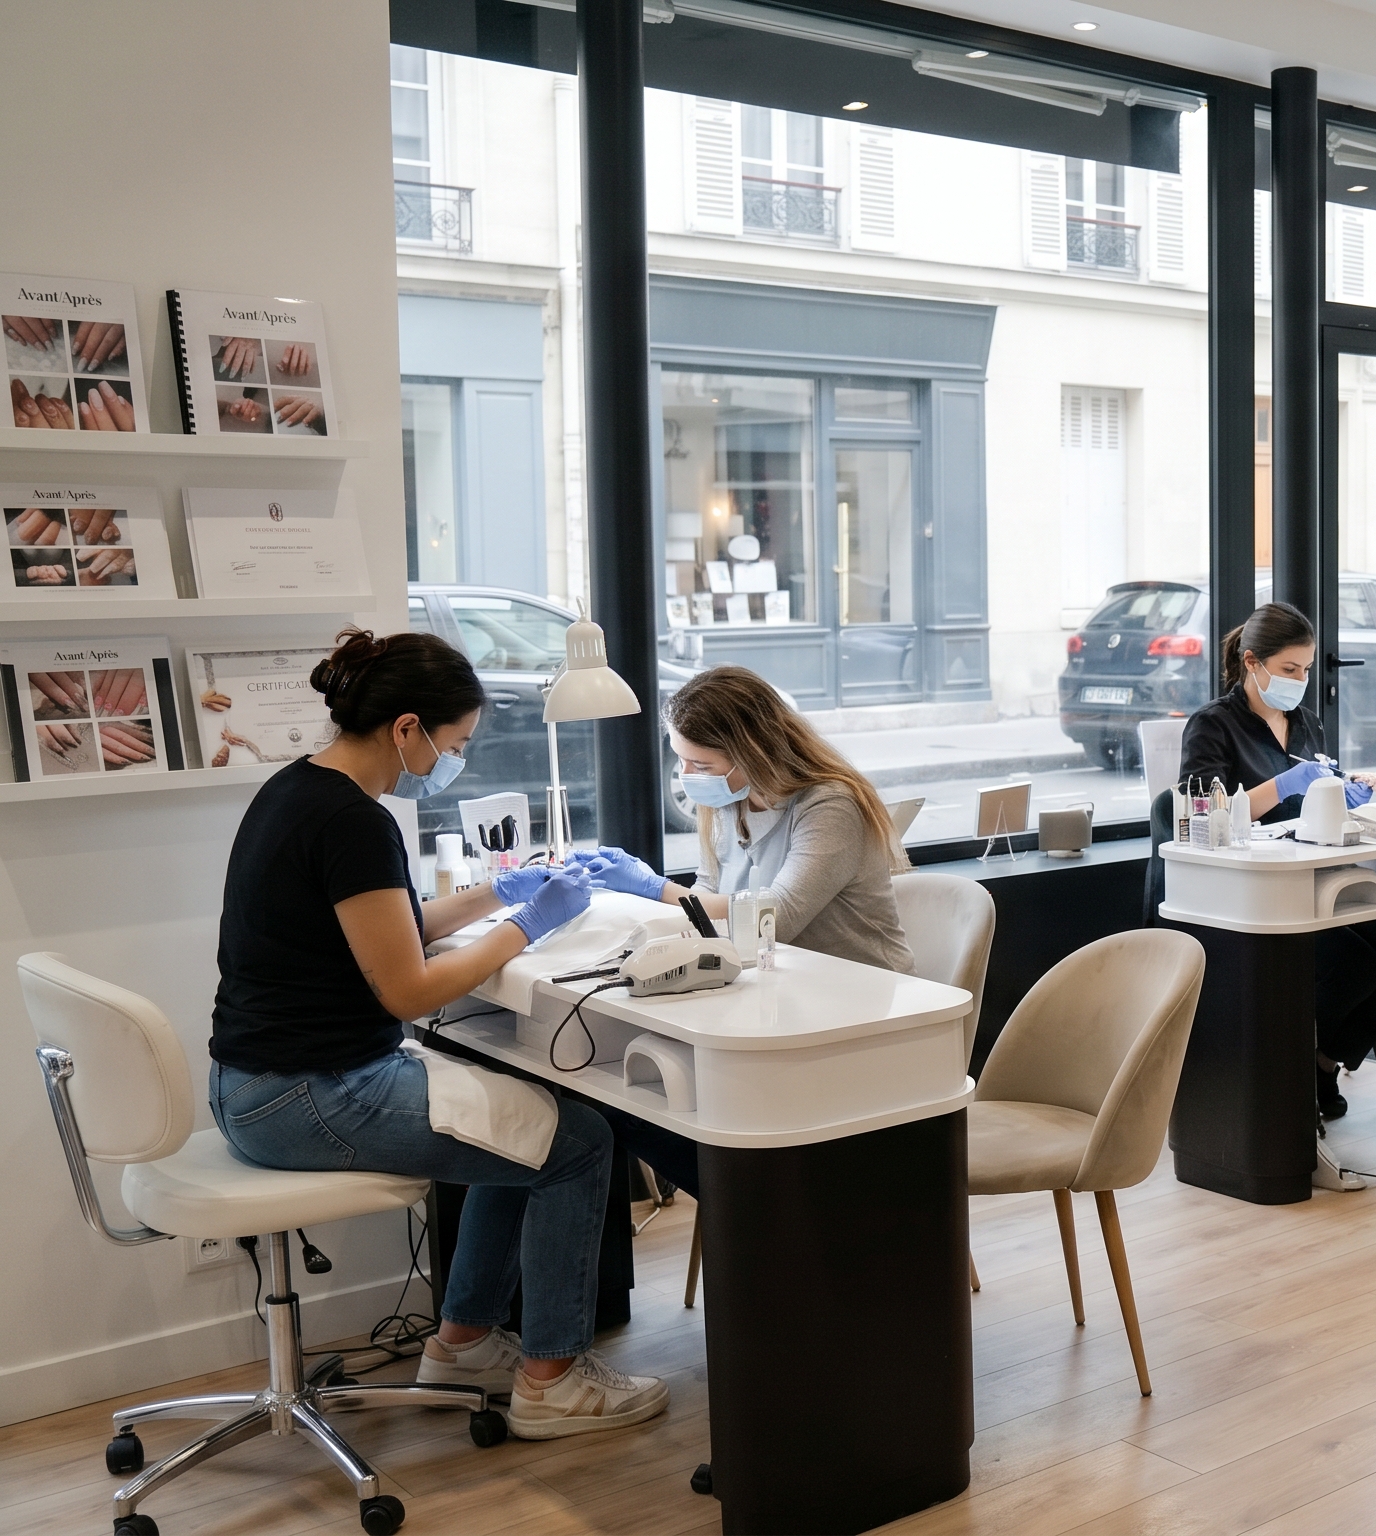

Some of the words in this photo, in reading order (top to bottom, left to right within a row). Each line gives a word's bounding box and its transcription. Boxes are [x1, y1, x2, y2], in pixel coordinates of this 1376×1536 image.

[17, 287, 102, 308] Avant/Après
[222, 307, 297, 326] Avant/Après
[32, 489, 97, 502] Avant/Après
